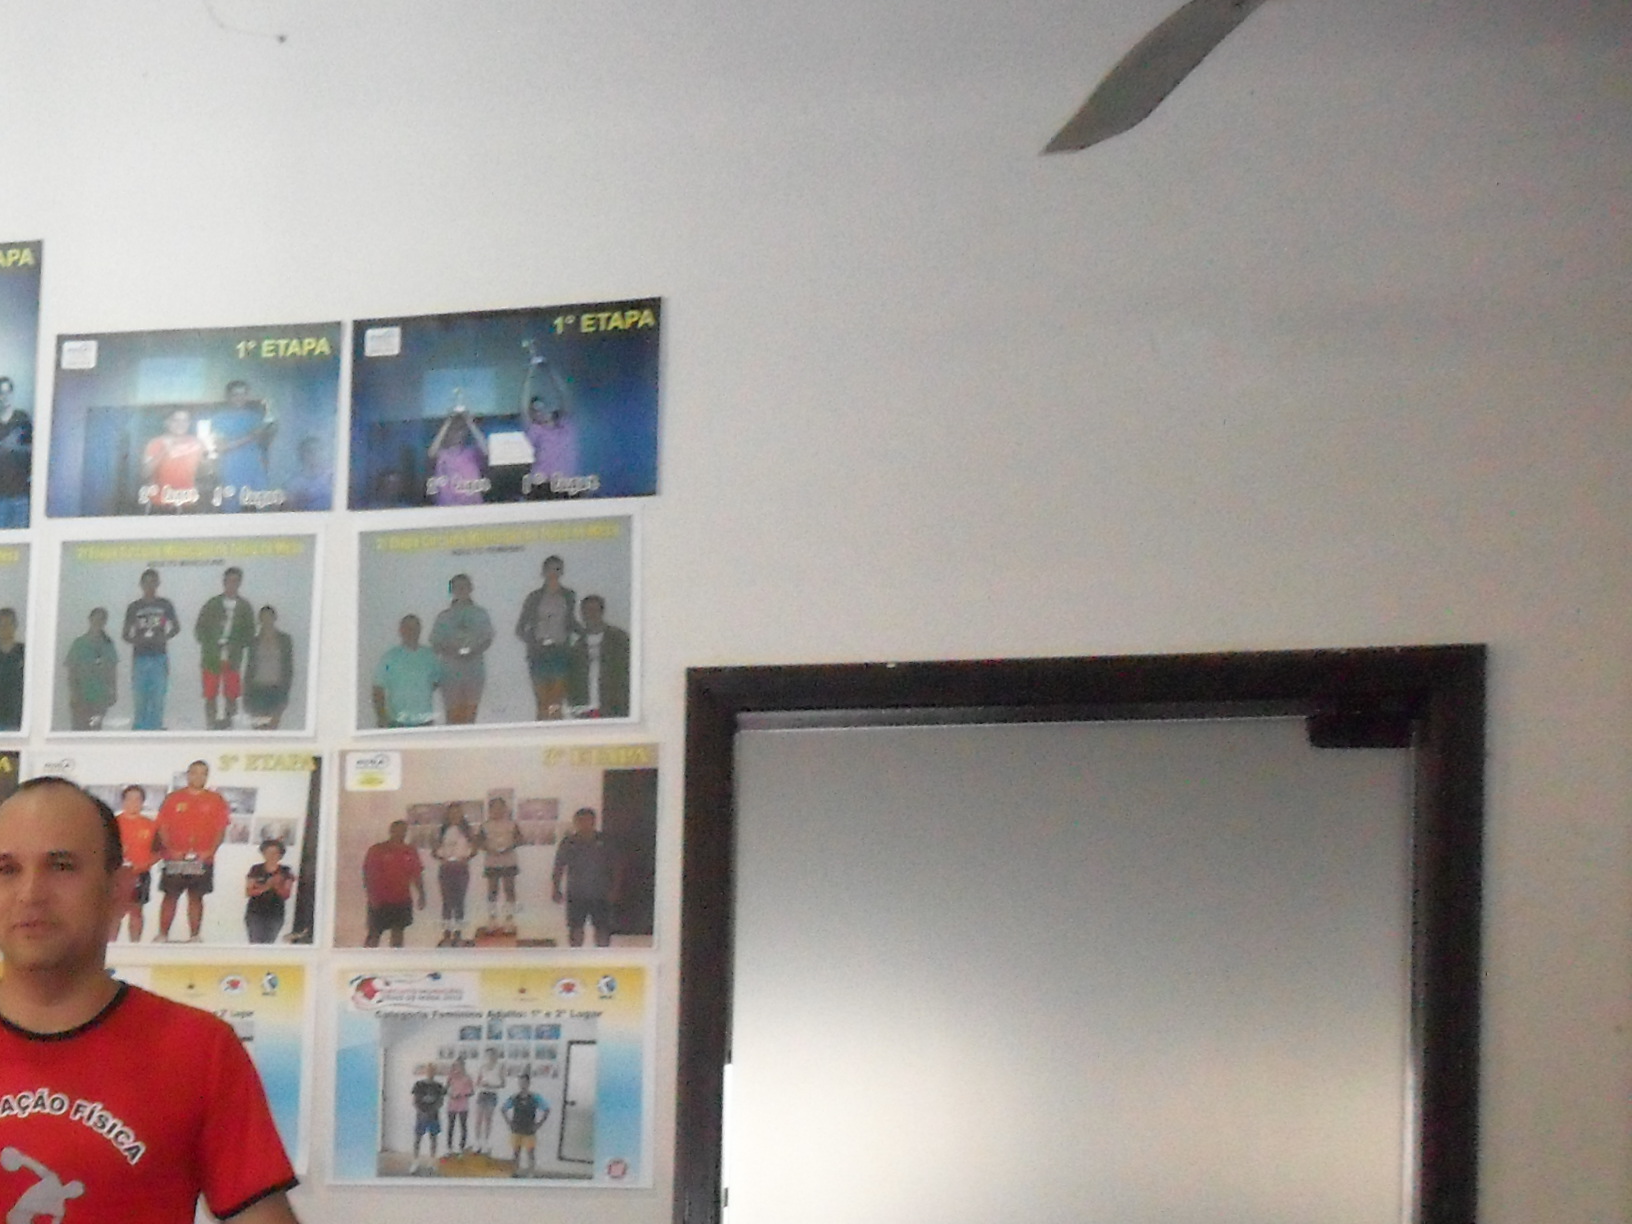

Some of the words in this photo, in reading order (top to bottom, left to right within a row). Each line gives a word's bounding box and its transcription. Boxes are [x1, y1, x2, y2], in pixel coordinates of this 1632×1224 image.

[580, 308, 656, 333] ETAPA
[261, 336, 331, 358] ETAPA
[70, 1099, 146, 1165] FÍSICA
